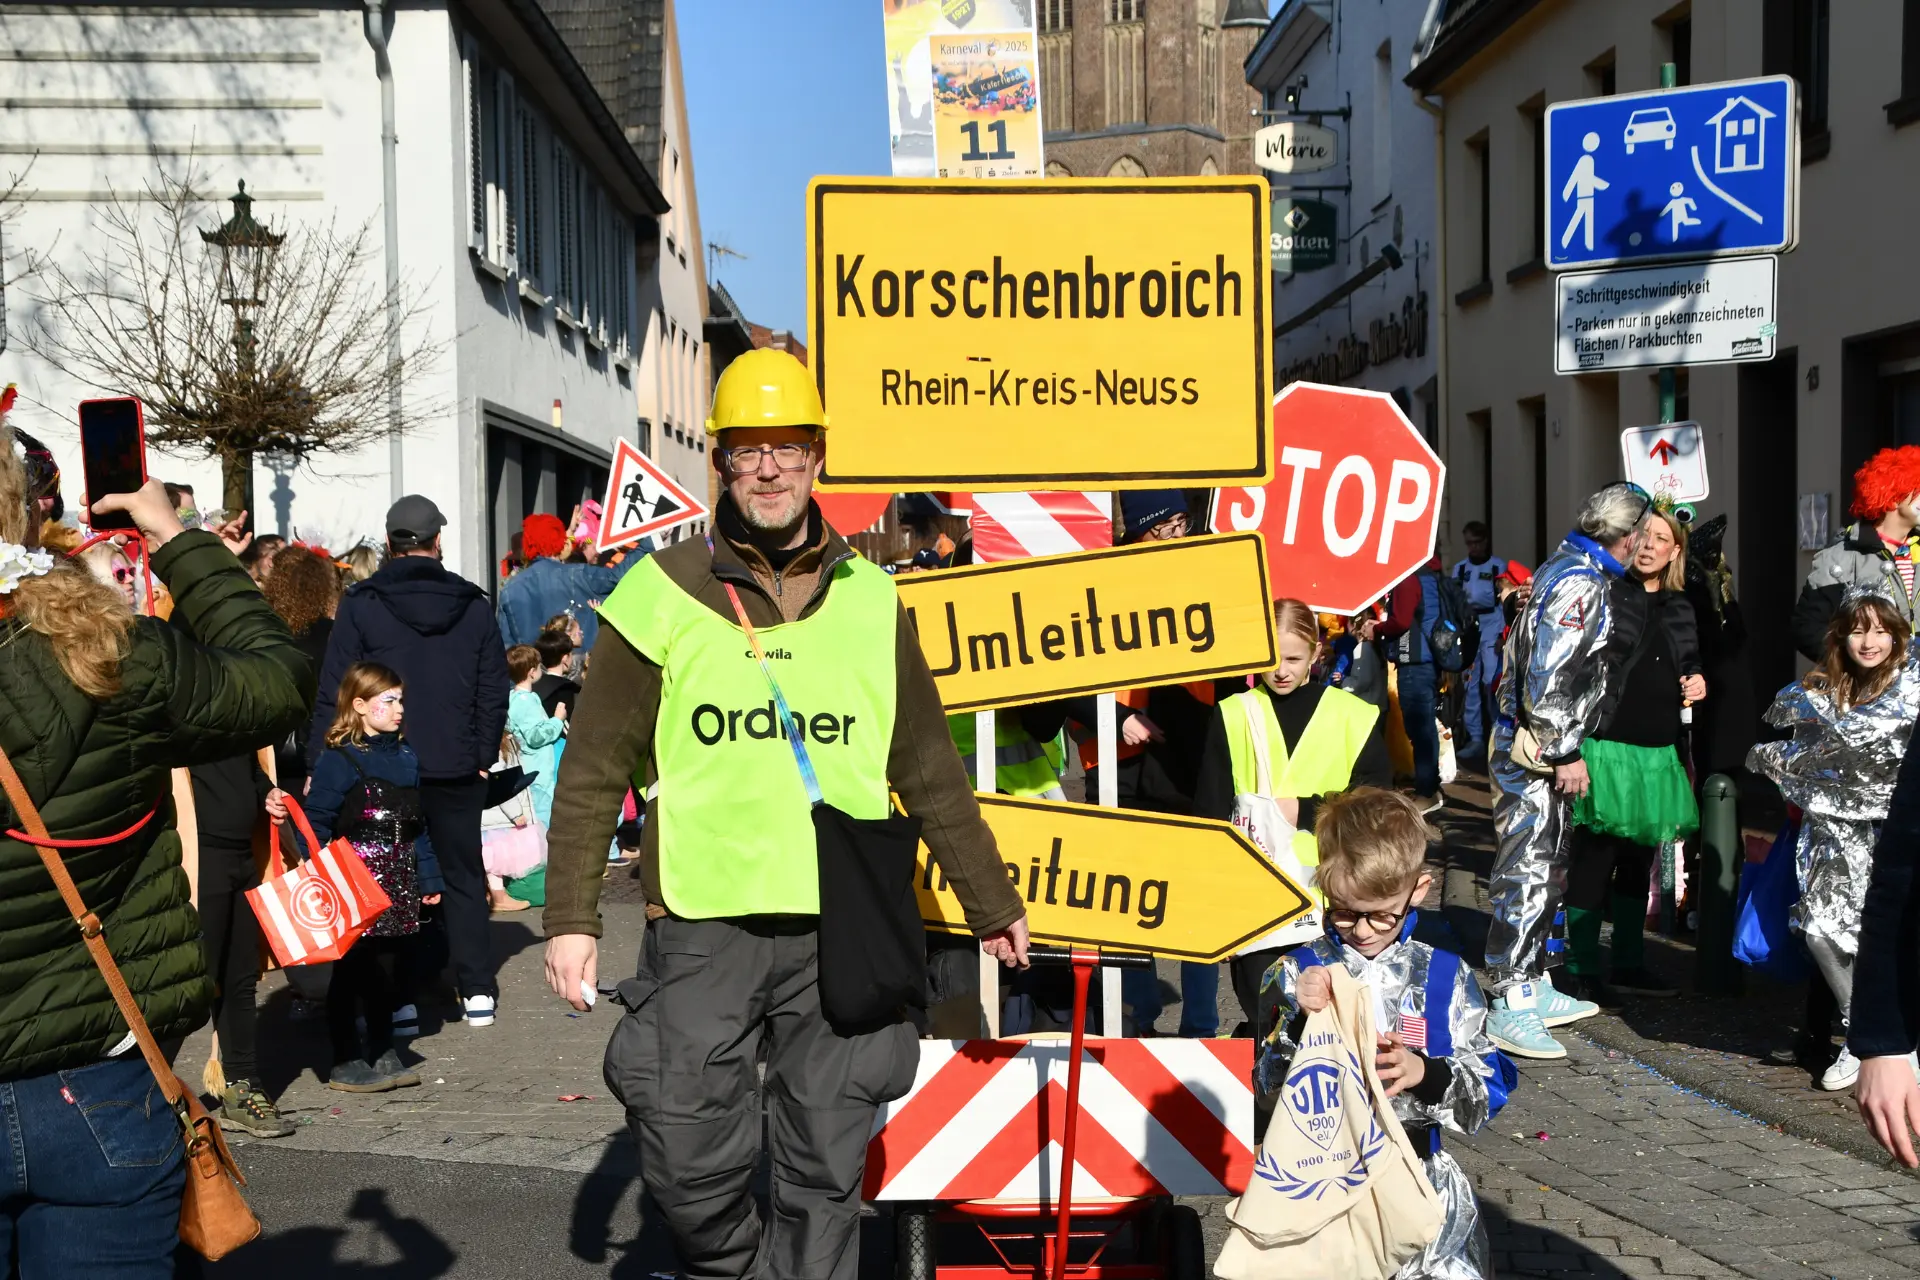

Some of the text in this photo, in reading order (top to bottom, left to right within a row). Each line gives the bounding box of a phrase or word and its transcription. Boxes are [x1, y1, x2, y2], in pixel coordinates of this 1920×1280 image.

[940, 40, 1028, 55] Karneval 2025
[960, 119, 1016, 161] 11
[1265, 134, 1328, 159] Marie
[836, 254, 1242, 319] Korschenbroich
[1576, 279, 1711, 305] Schrittgeschwindigkeit
[1575, 316, 1615, 332] Parken
[1618, 313, 1636, 329] nur
[1640, 312, 1651, 327] in
[1654, 305, 1765, 329] gekennzeichneten
[1574, 336, 1619, 353] Flächen
[1628, 331, 1703, 349] Parkbuchten
[907, 587, 1216, 677] Umleitung
[744, 647, 793, 660] cwila
[691, 699, 856, 747] Ordner
[1306, 1115, 1336, 1132] 1900
[1296, 1150, 1352, 1170] 1900 2025
